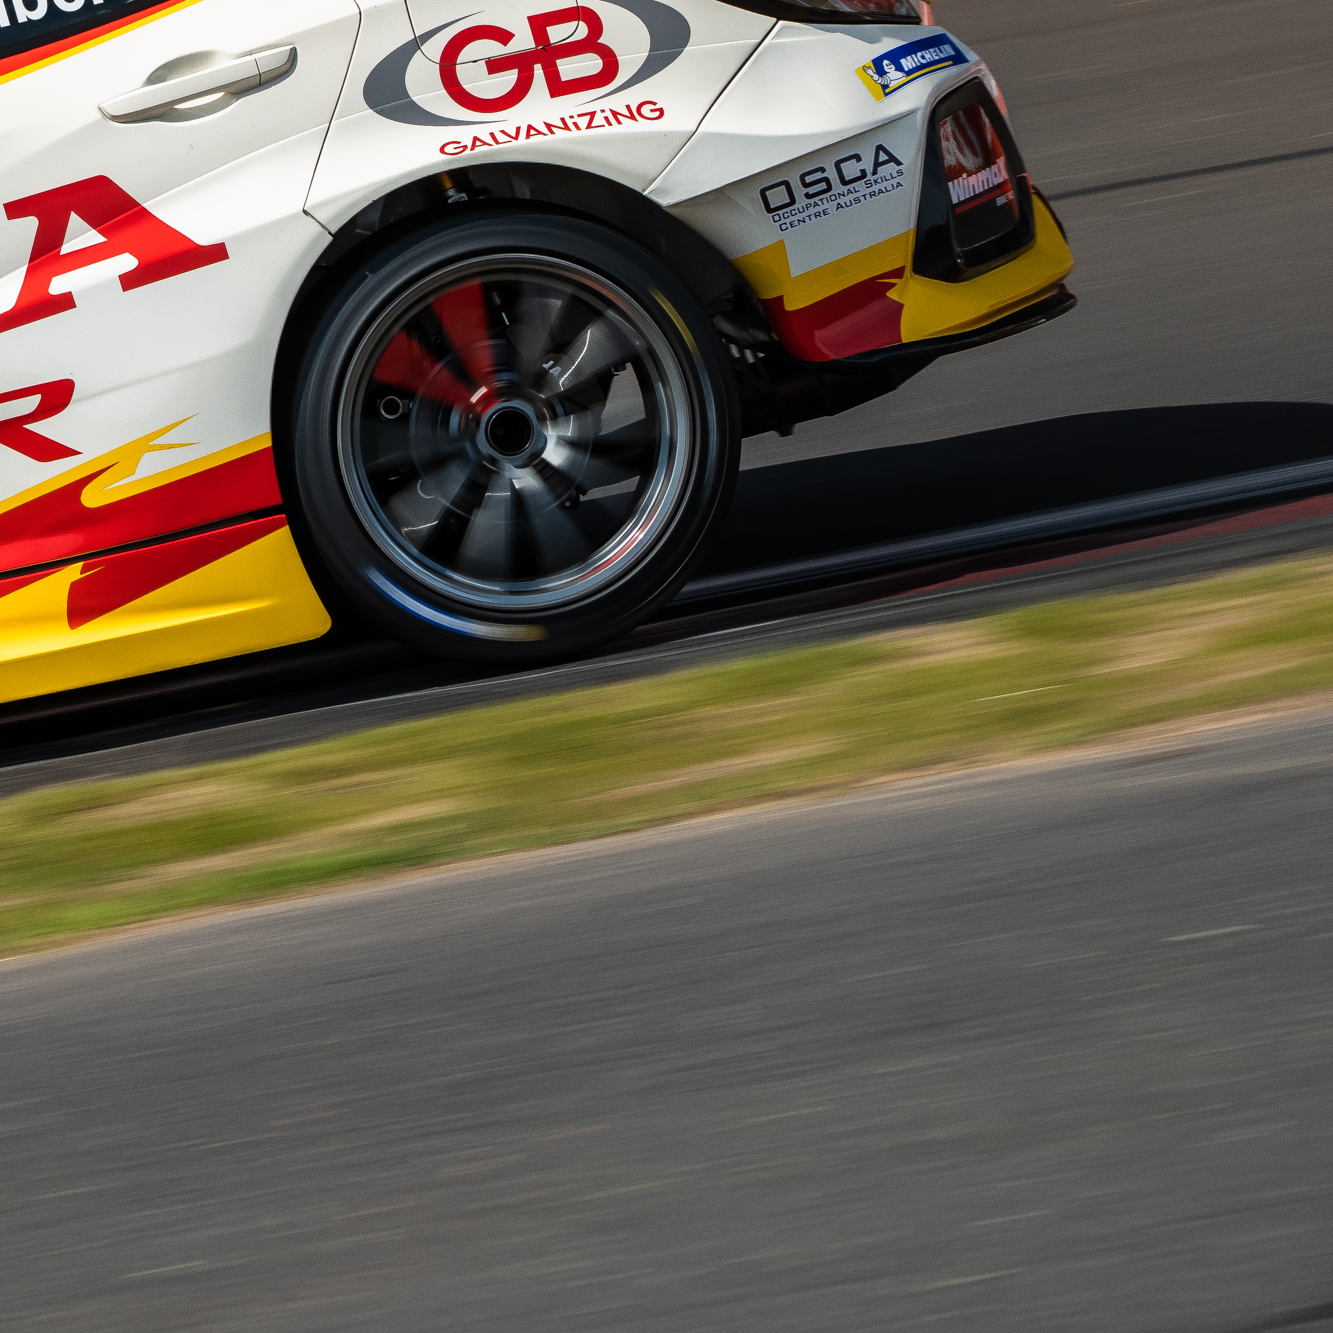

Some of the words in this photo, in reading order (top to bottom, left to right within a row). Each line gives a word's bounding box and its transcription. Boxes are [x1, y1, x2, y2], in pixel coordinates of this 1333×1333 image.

[438, 4, 620, 114] GB
[899, 43, 956, 73] MICHELIN
[759, 143, 904, 215] OSCA
